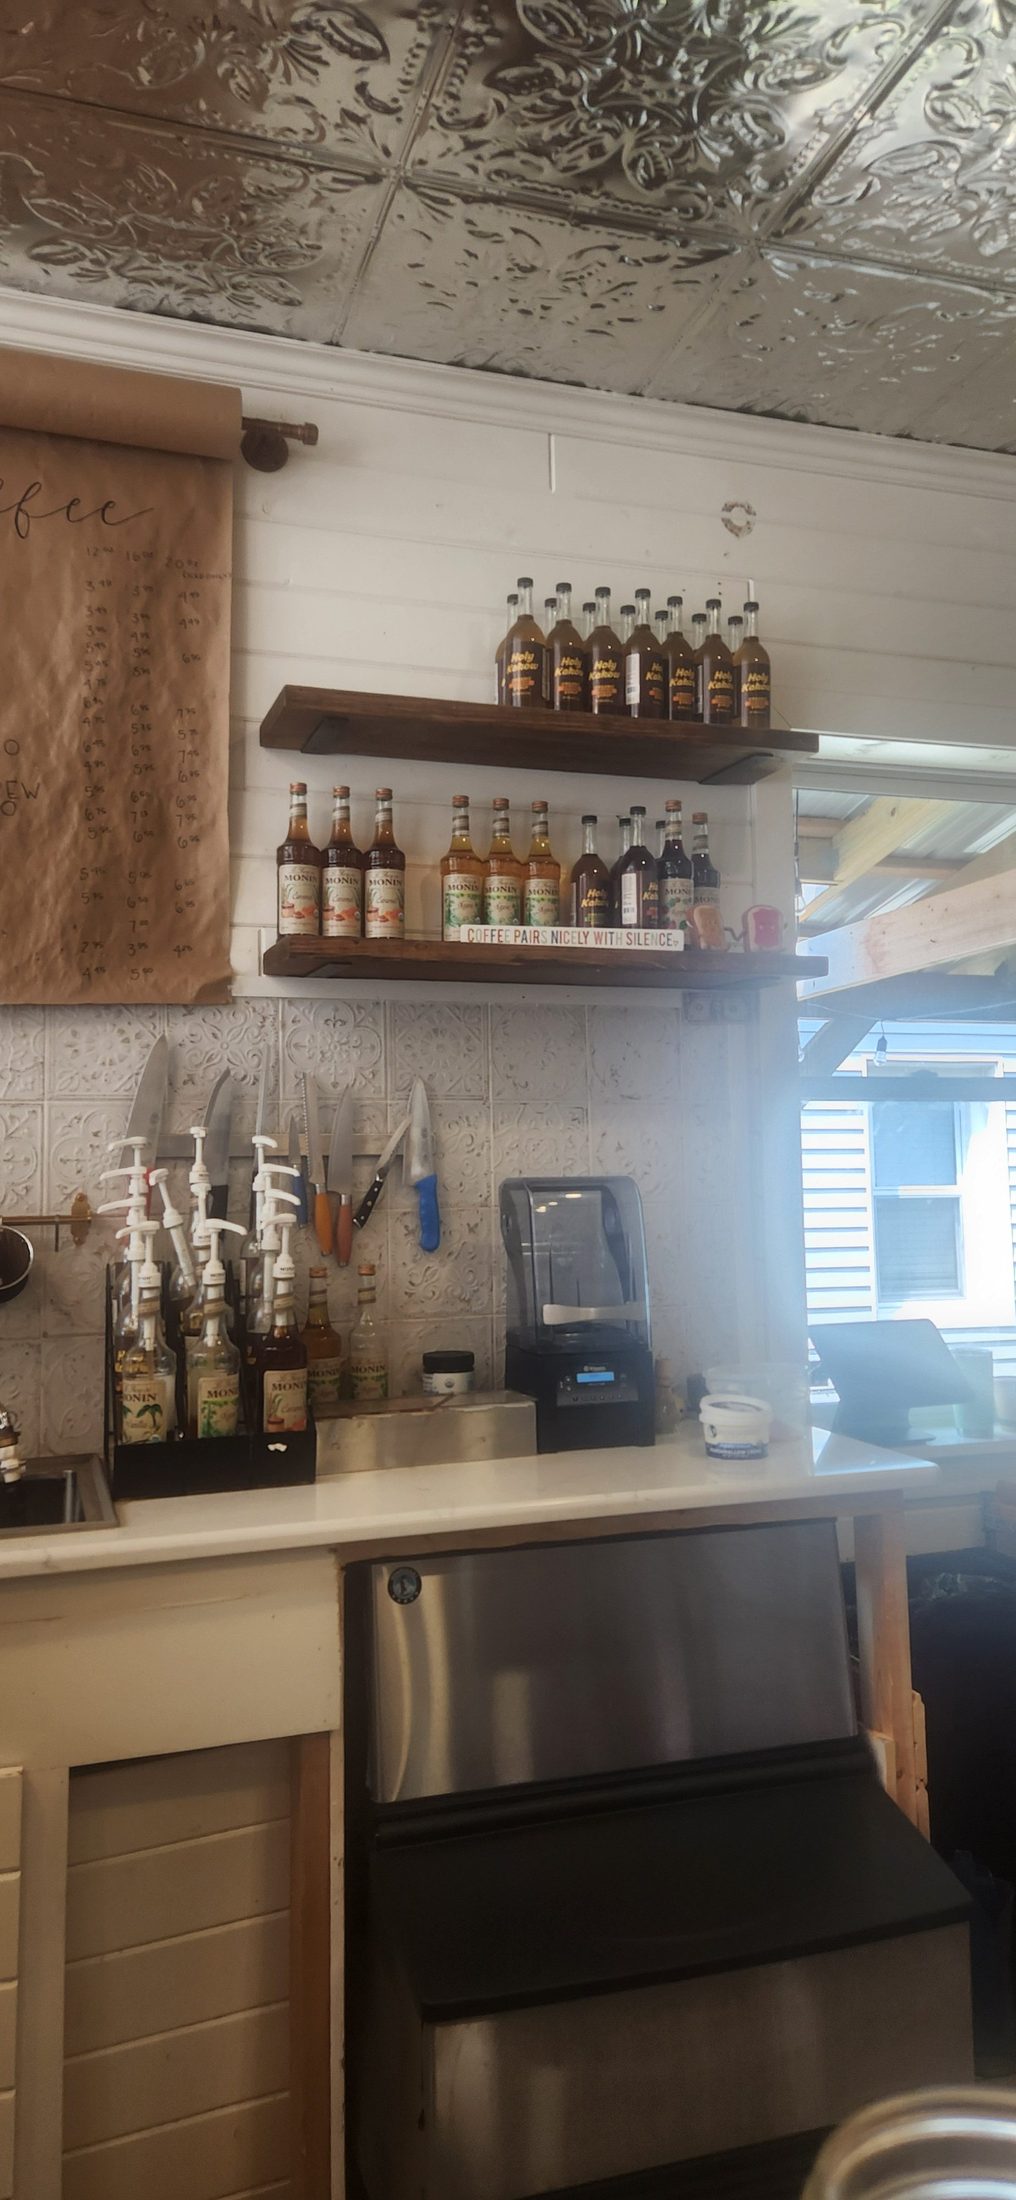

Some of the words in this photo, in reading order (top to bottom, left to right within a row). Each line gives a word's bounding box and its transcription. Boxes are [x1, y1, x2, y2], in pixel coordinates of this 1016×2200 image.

[284, 874, 319, 882] MONIN
[326, 877, 358, 885] MONIN
[369, 878, 402, 886] MONIN
[485, 885, 517, 893] MONIN
[528, 888, 560, 896] MONIN
[467, 928, 511, 943] COFFEE
[514, 929, 549, 944] PAIRS
[551, 930, 590, 945] NICELY
[593, 931, 623, 946] WITH
[626, 932, 673, 947] SILENCE
[351, 1364, 386, 1374] MONIN
